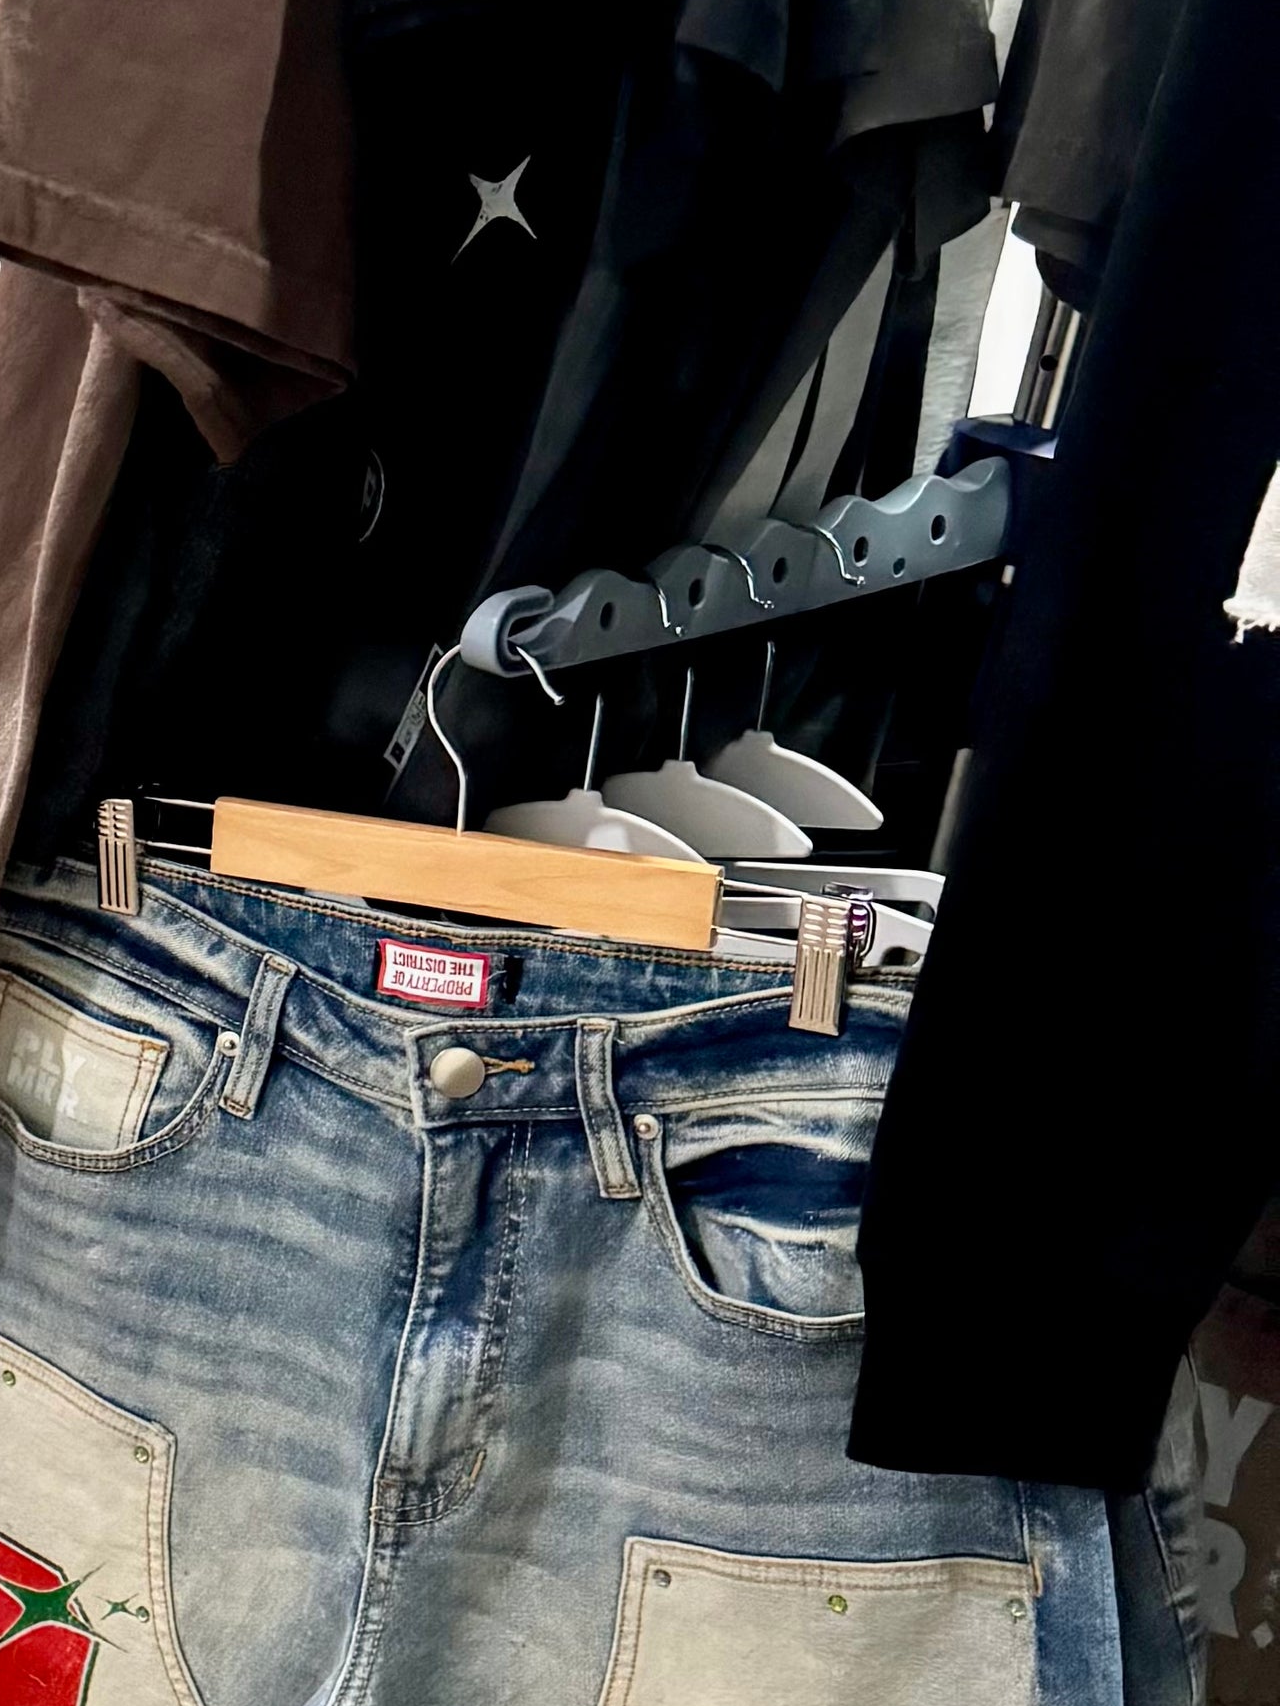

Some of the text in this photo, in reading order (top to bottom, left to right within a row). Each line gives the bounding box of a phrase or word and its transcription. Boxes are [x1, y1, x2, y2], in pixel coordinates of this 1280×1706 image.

[392, 951, 475, 977] THE DISTRICT
[390, 970, 473, 996] PROPERTY OF
